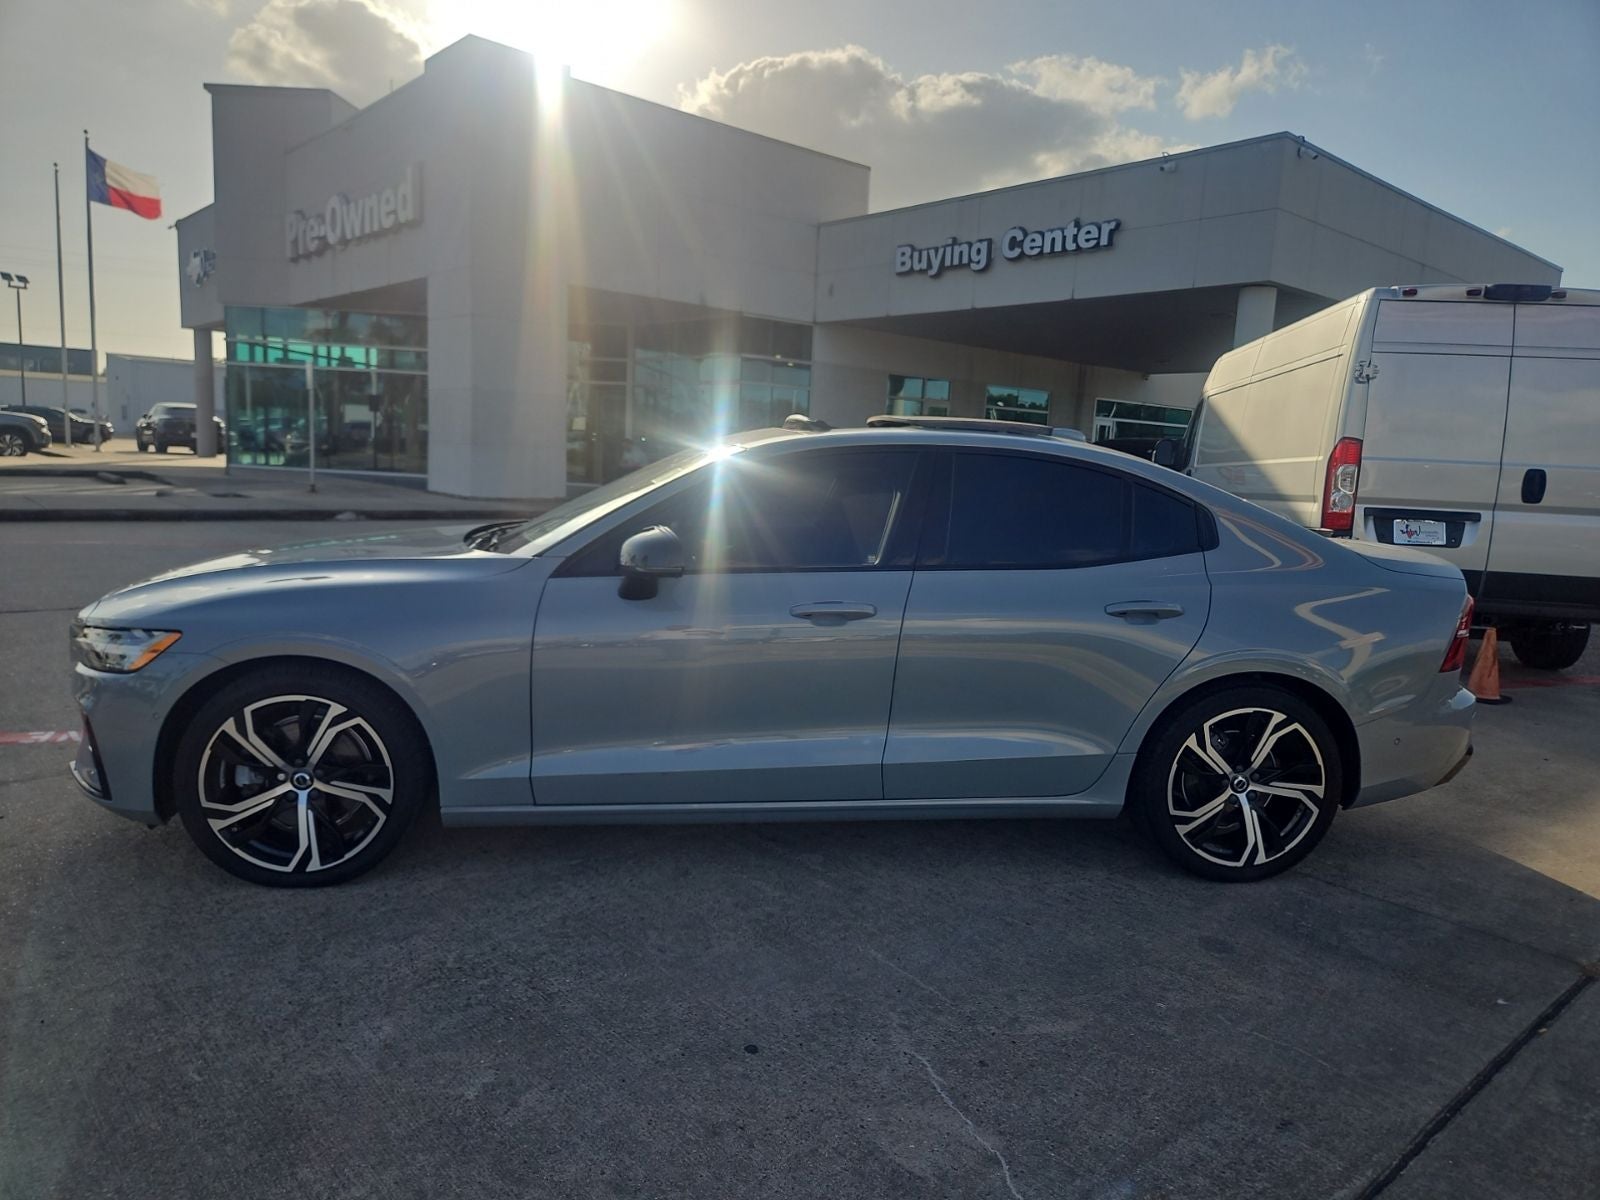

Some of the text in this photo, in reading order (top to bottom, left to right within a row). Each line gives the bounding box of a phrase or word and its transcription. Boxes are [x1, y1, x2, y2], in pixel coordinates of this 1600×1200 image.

[285, 165, 420, 260] Pre-Owned
[895, 219, 1120, 277] Buying Center
